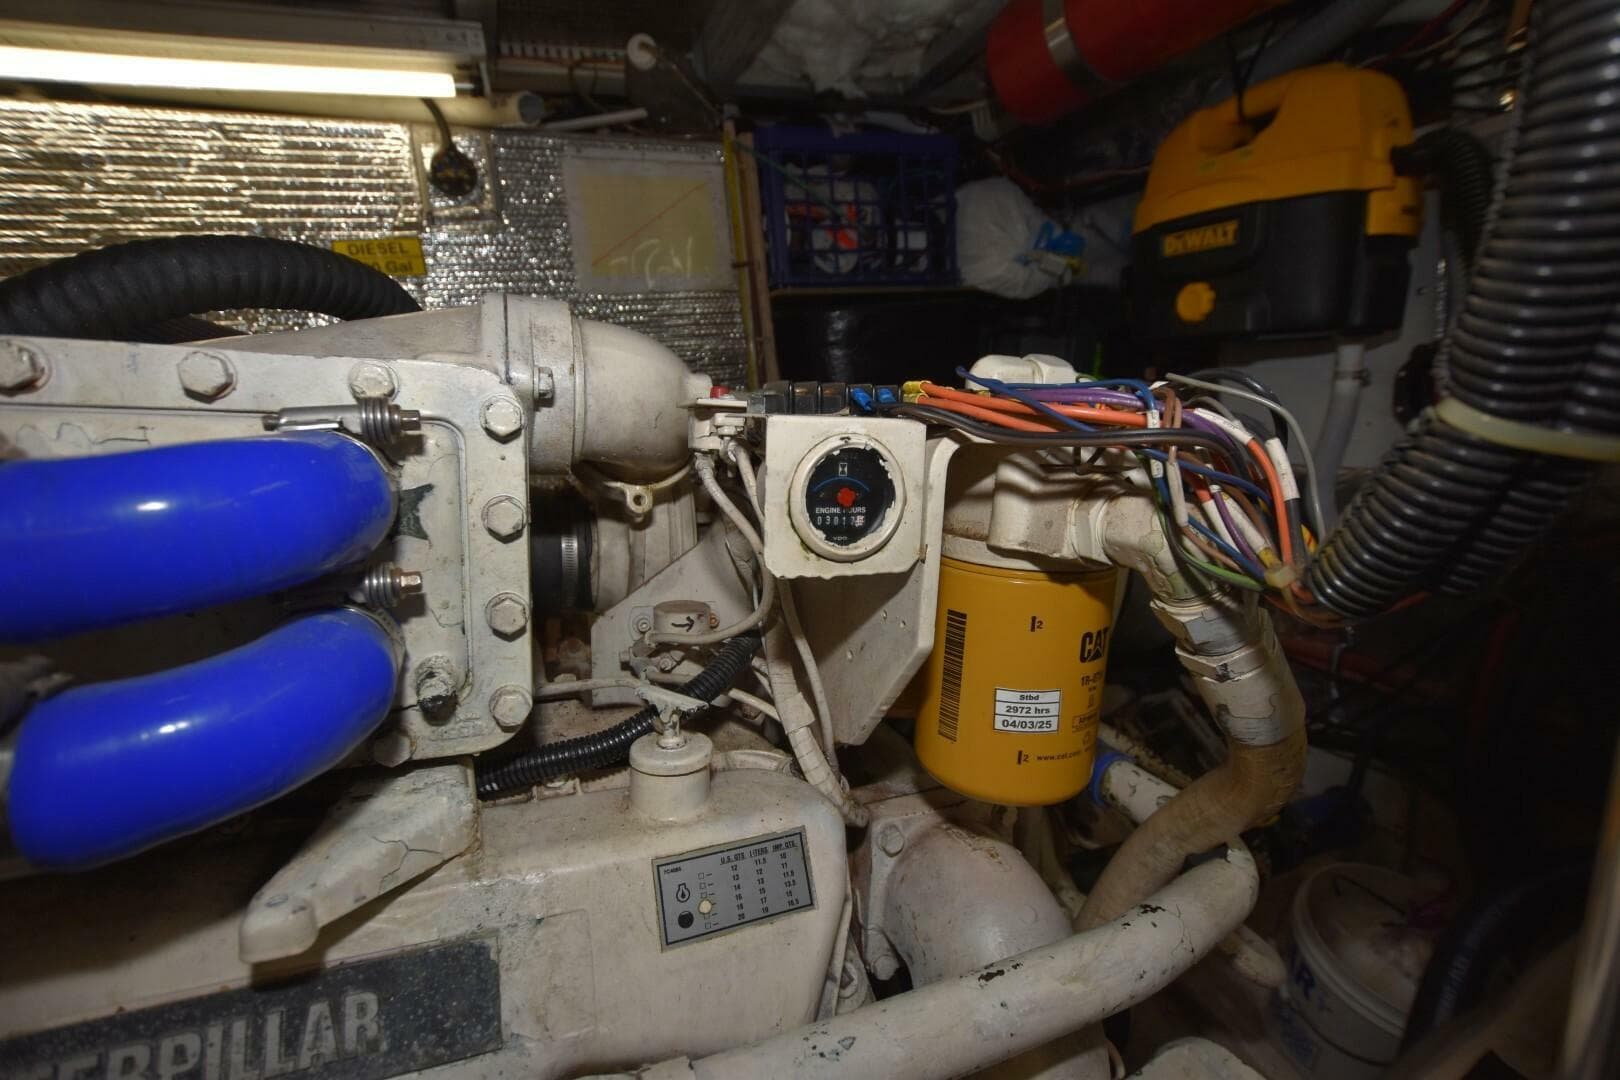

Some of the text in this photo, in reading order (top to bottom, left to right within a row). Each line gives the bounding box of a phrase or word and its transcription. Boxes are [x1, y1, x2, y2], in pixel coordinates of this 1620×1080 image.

[347, 242, 408, 255] DIESEL
[815, 506, 841, 514] ENGINE
[1080, 626, 1109, 663] CAT
[1005, 705, 1050, 714] 2972 hrs
[1001, 719, 1052, 729] 04/03/25
